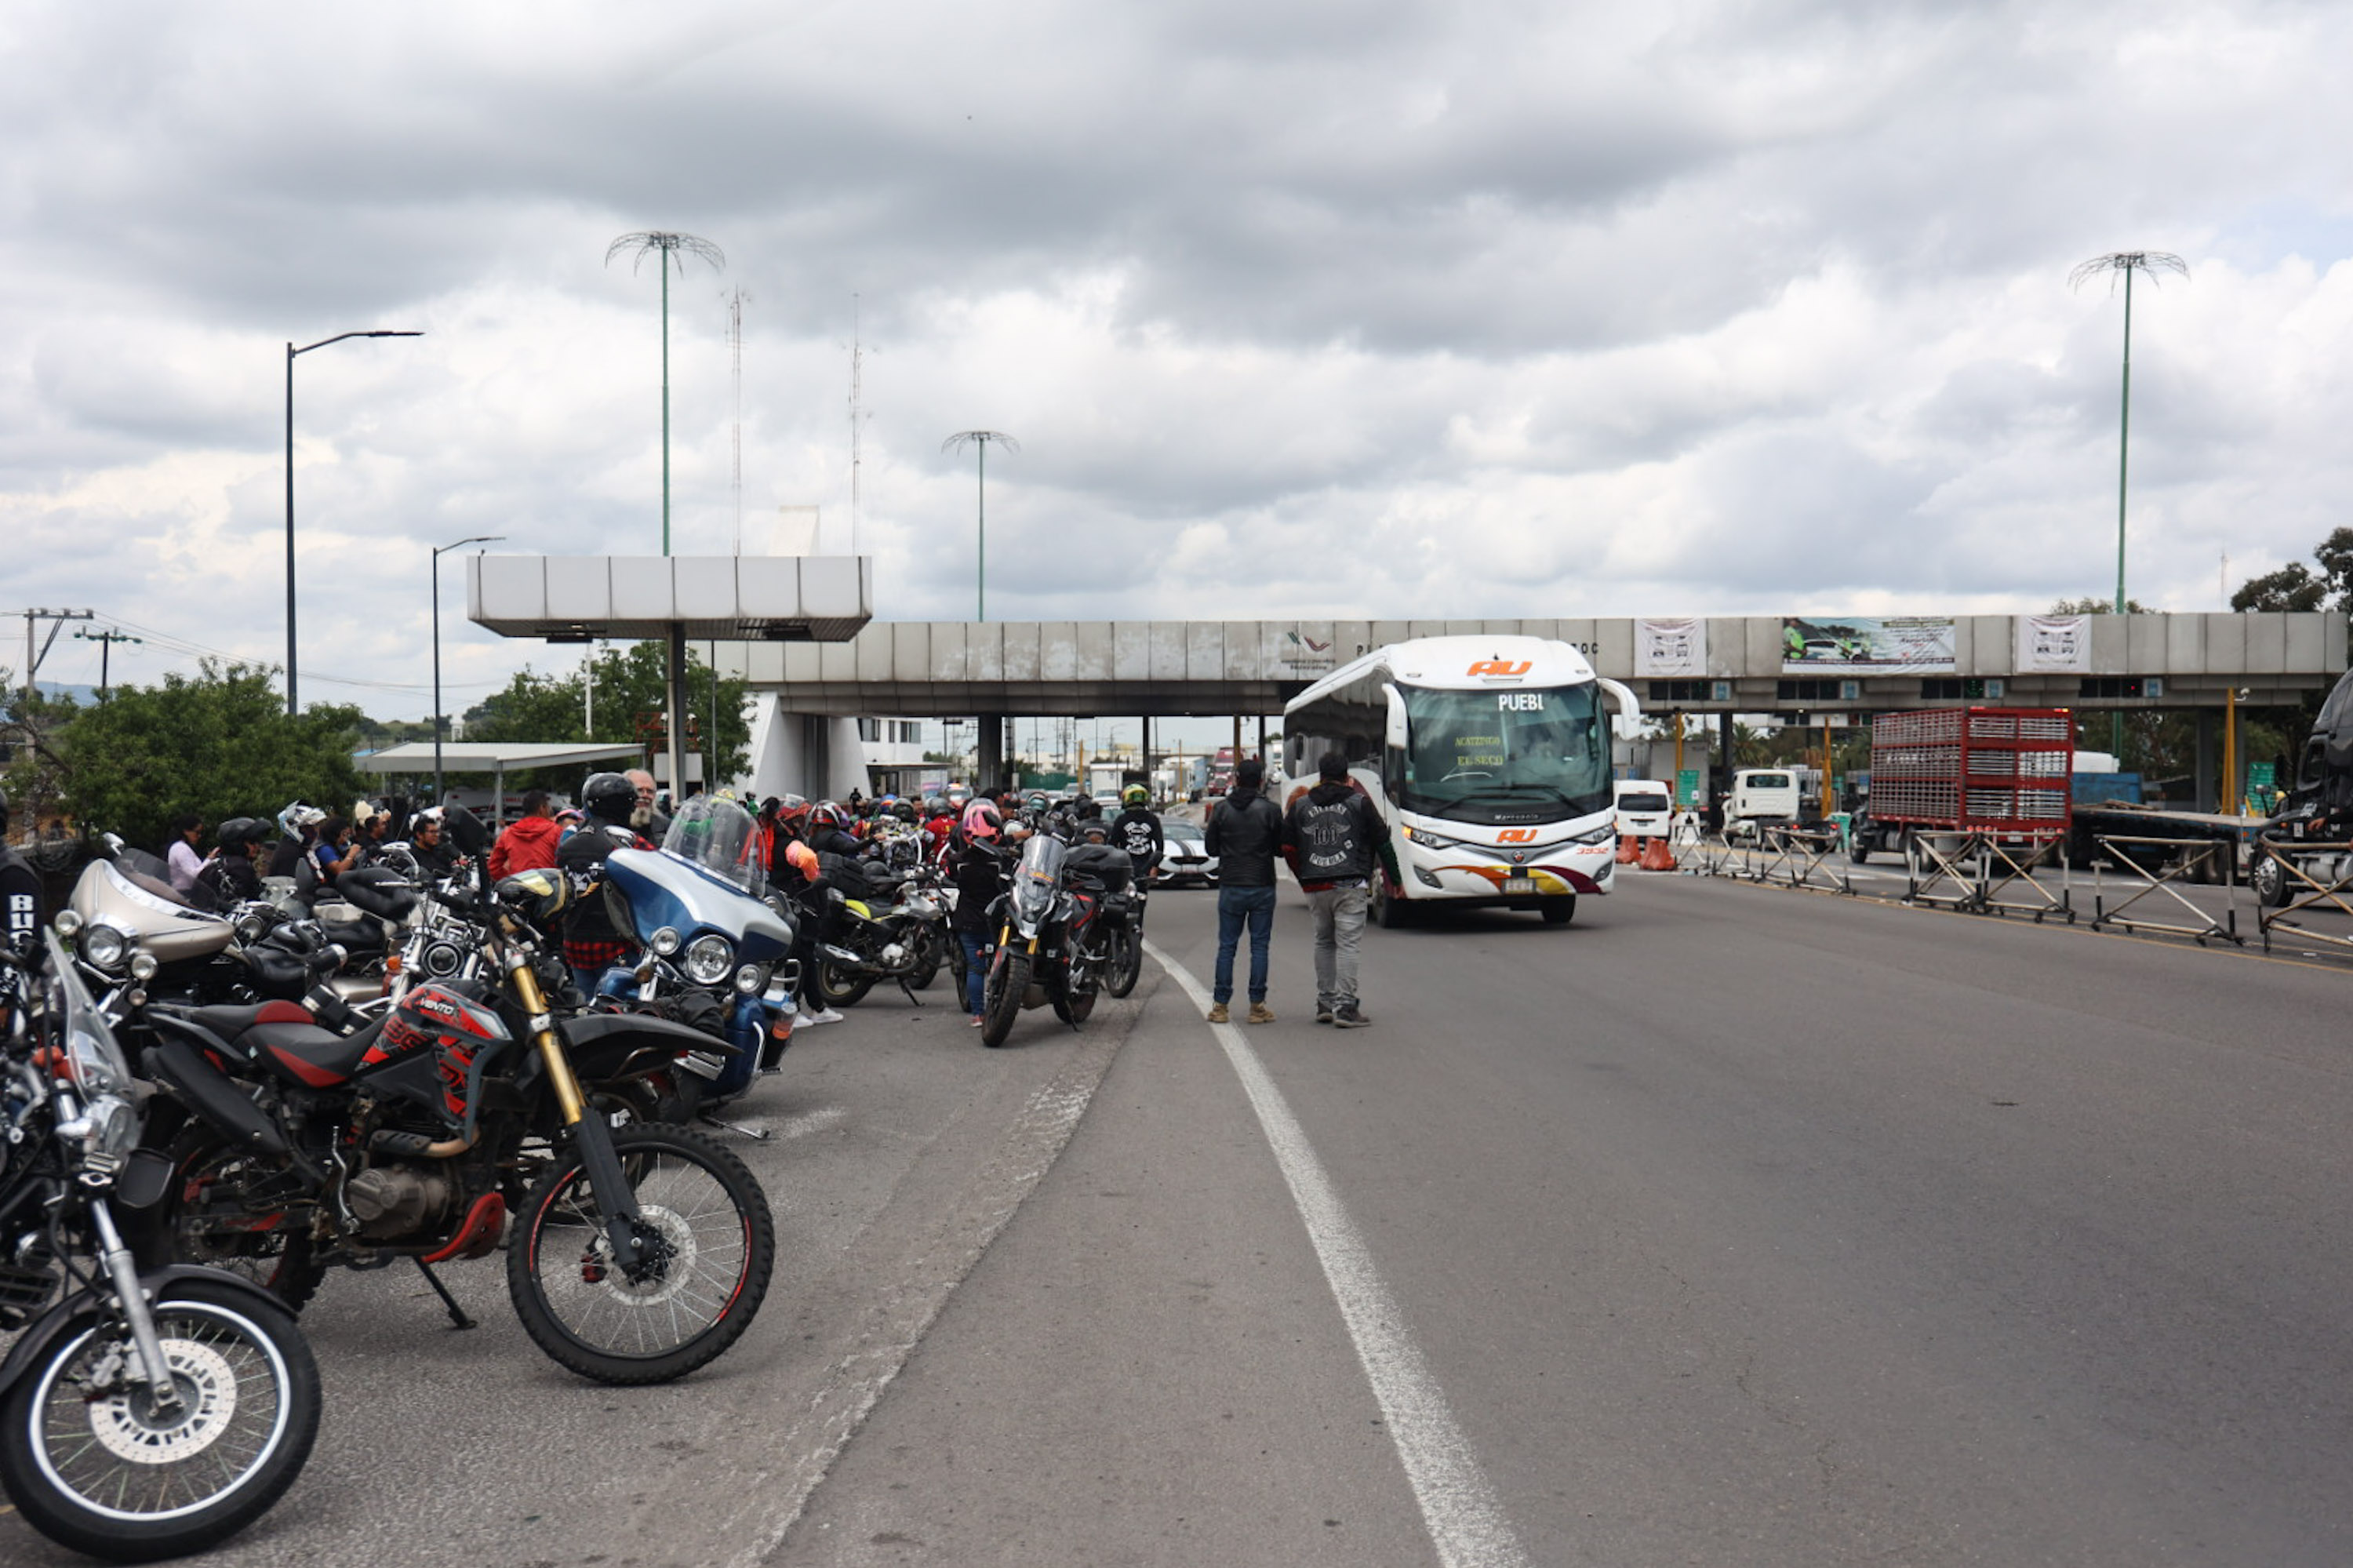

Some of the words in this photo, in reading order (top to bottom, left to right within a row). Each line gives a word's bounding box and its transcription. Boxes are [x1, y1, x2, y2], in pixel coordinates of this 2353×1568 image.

[1467, 660, 1533, 676] AU
[1497, 828, 1538, 843] AU
[420, 997, 454, 1015] VENTO
